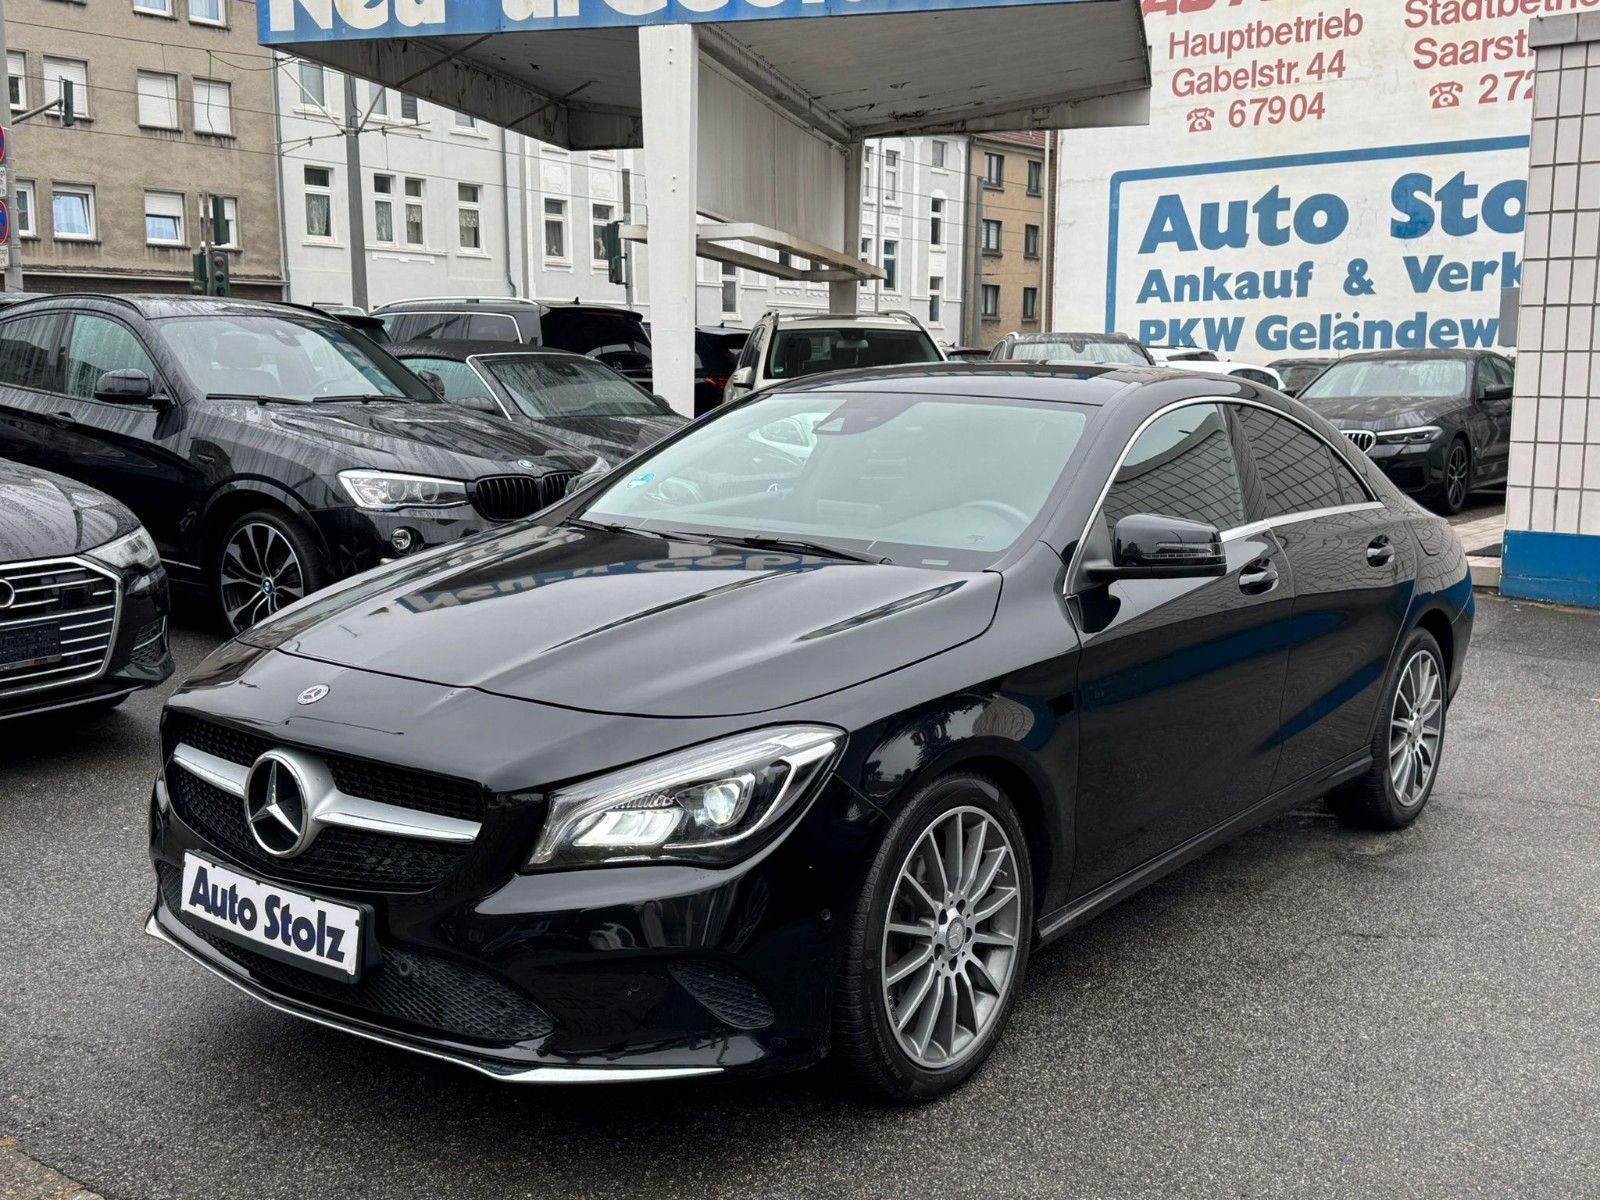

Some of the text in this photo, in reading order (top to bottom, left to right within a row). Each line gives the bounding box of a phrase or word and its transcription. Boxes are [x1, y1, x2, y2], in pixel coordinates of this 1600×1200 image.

[1168, 8, 1364, 59] Hauptbetrieb
[1413, 29, 1536, 69] Saarst
[1172, 49, 1346, 97] Gabelstr. 44
[1228, 92, 1326, 128] 67904
[1138, 184, 1349, 254] Auto
[1136, 260, 1315, 304] Ankauf
[1342, 258, 1376, 296] &
[1138, 311, 1500, 352] PKW Geländew
[188, 865, 346, 963] Auto Stolz
